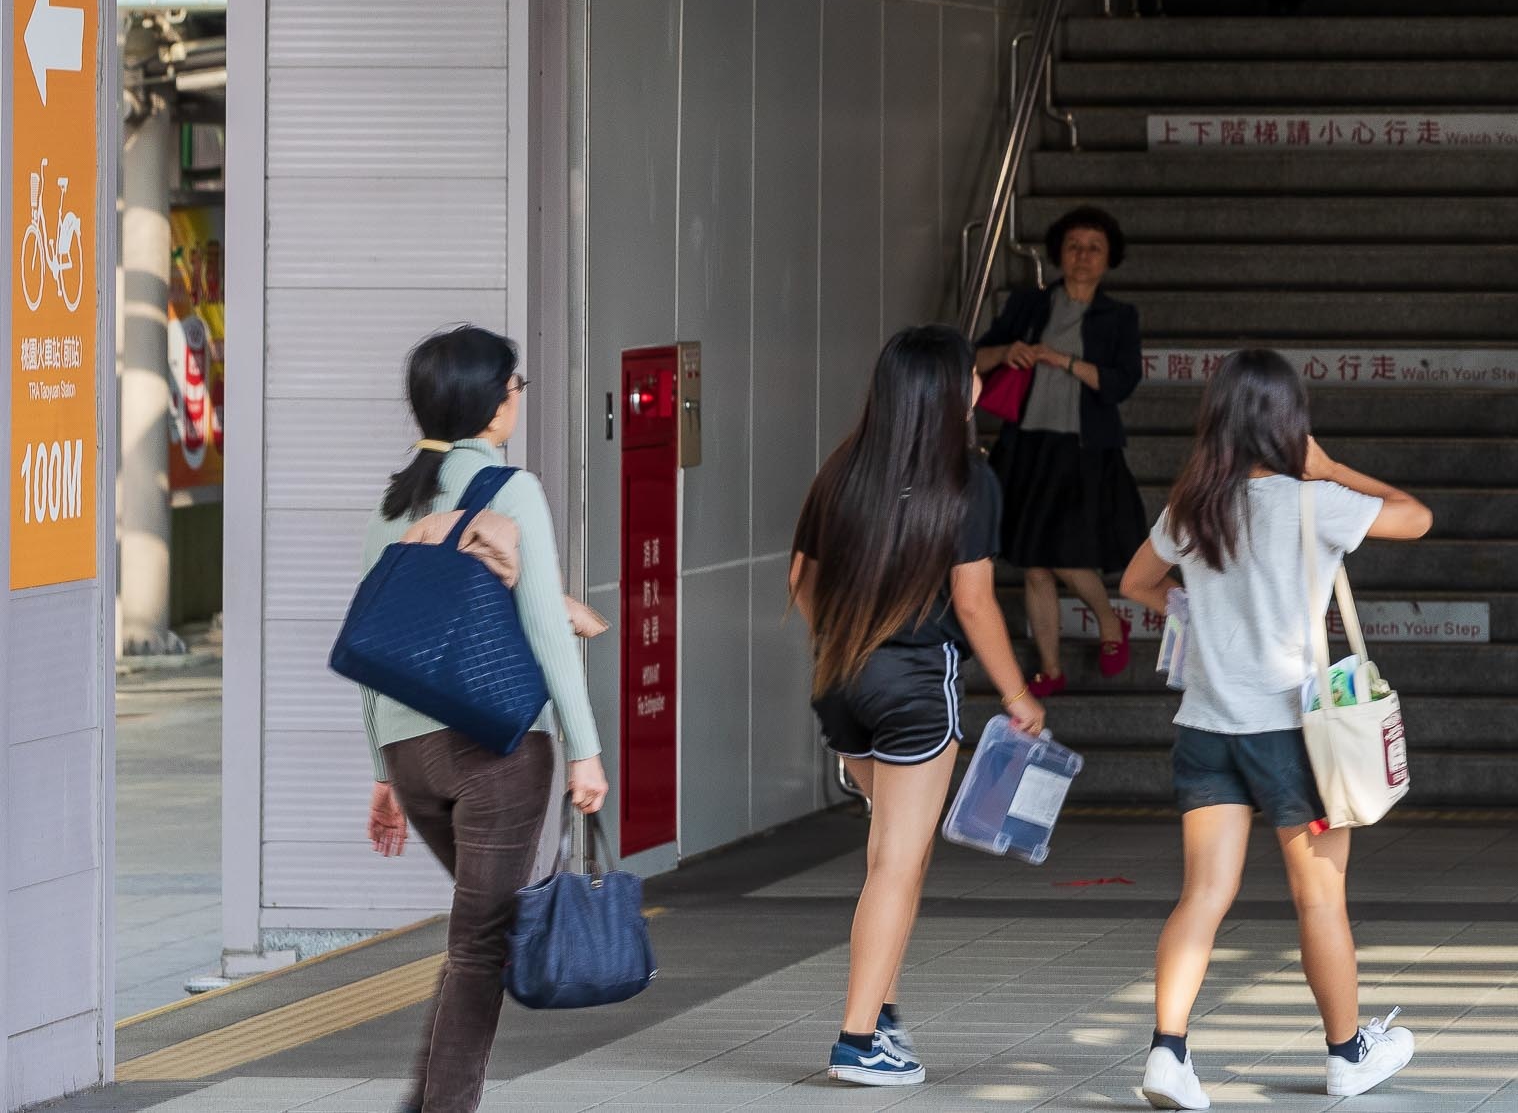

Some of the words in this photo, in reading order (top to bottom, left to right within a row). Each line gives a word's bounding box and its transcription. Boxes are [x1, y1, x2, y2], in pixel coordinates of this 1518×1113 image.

[1157, 118, 1442, 147] 上下階梯請小心行走
[1445, 132, 1493, 146] Watch
[1400, 366, 1450, 381] Watch
[1452, 366, 1488, 381] Your
[20, 438, 83, 524] 100M
[1404, 621, 1439, 636] Your
[1444, 621, 1482, 639] Step
